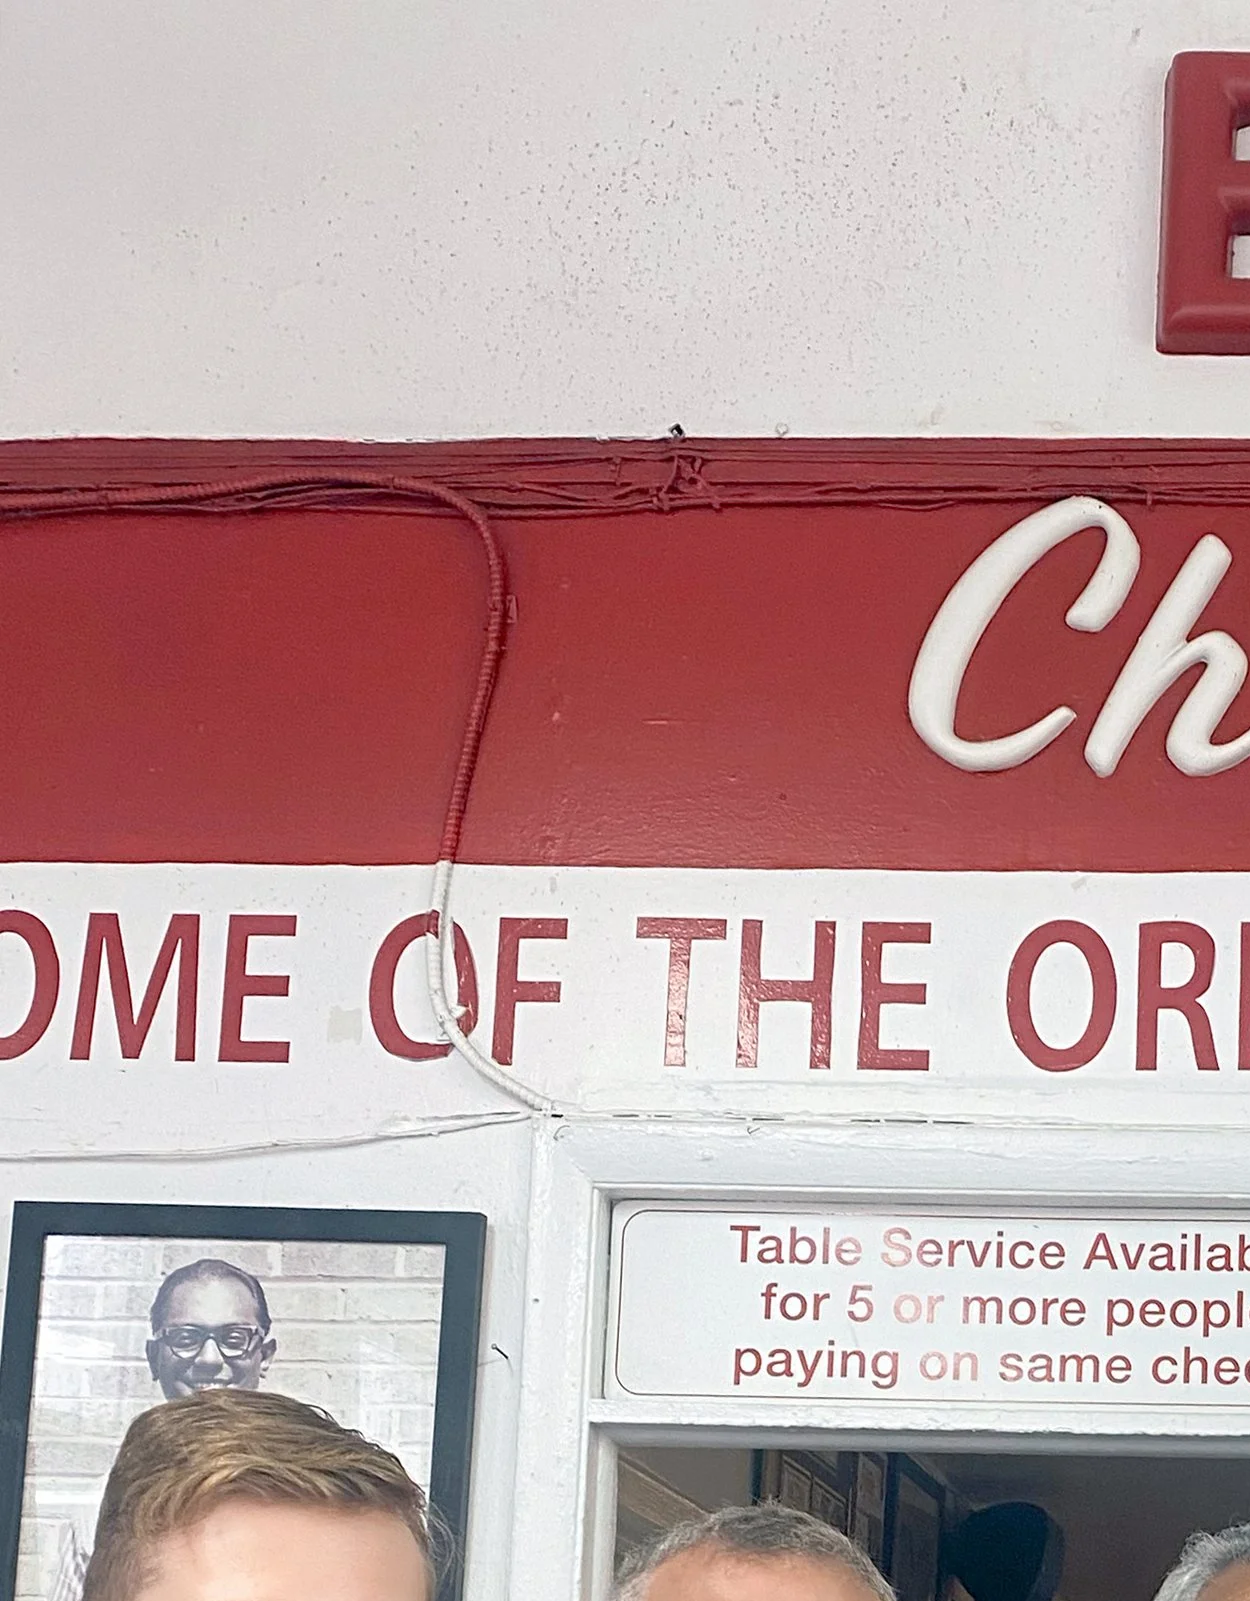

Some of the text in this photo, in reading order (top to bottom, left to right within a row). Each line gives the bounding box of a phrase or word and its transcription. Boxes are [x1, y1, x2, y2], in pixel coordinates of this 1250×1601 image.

[368, 909, 569, 1067] OF
[636, 917, 933, 1072] THE
[730, 1224, 862, 1265] Table
[881, 1227, 1066, 1270] Service
[761, 1282, 831, 1321] for
[847, 1283, 875, 1323] 5
[893, 1295, 944, 1324] or
[962, 1295, 1087, 1327] more
[733, 1340, 899, 1389] paying
[919, 1351, 978, 1381] on
[999, 1352, 1133, 1384] same
